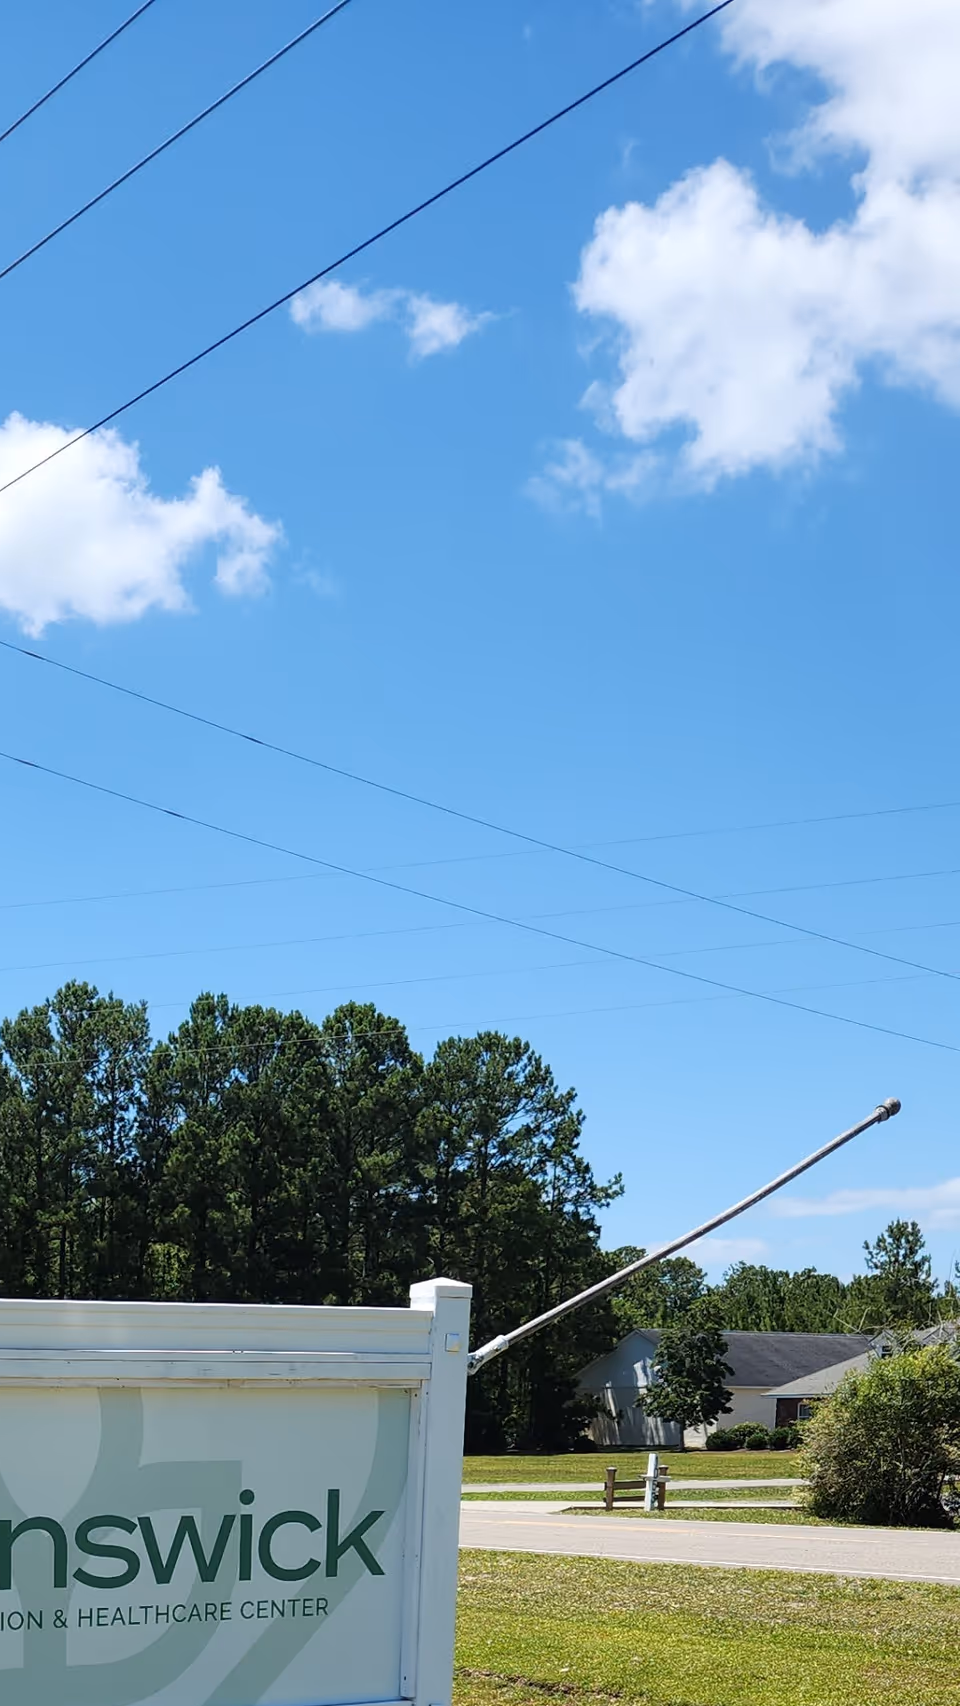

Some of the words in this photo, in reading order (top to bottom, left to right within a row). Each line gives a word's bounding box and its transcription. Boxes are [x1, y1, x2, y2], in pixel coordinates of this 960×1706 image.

[52, 1608, 70, 1629] &
[77, 1600, 234, 1629] HEALTHCARE
[239, 1597, 330, 1621] CENTER
